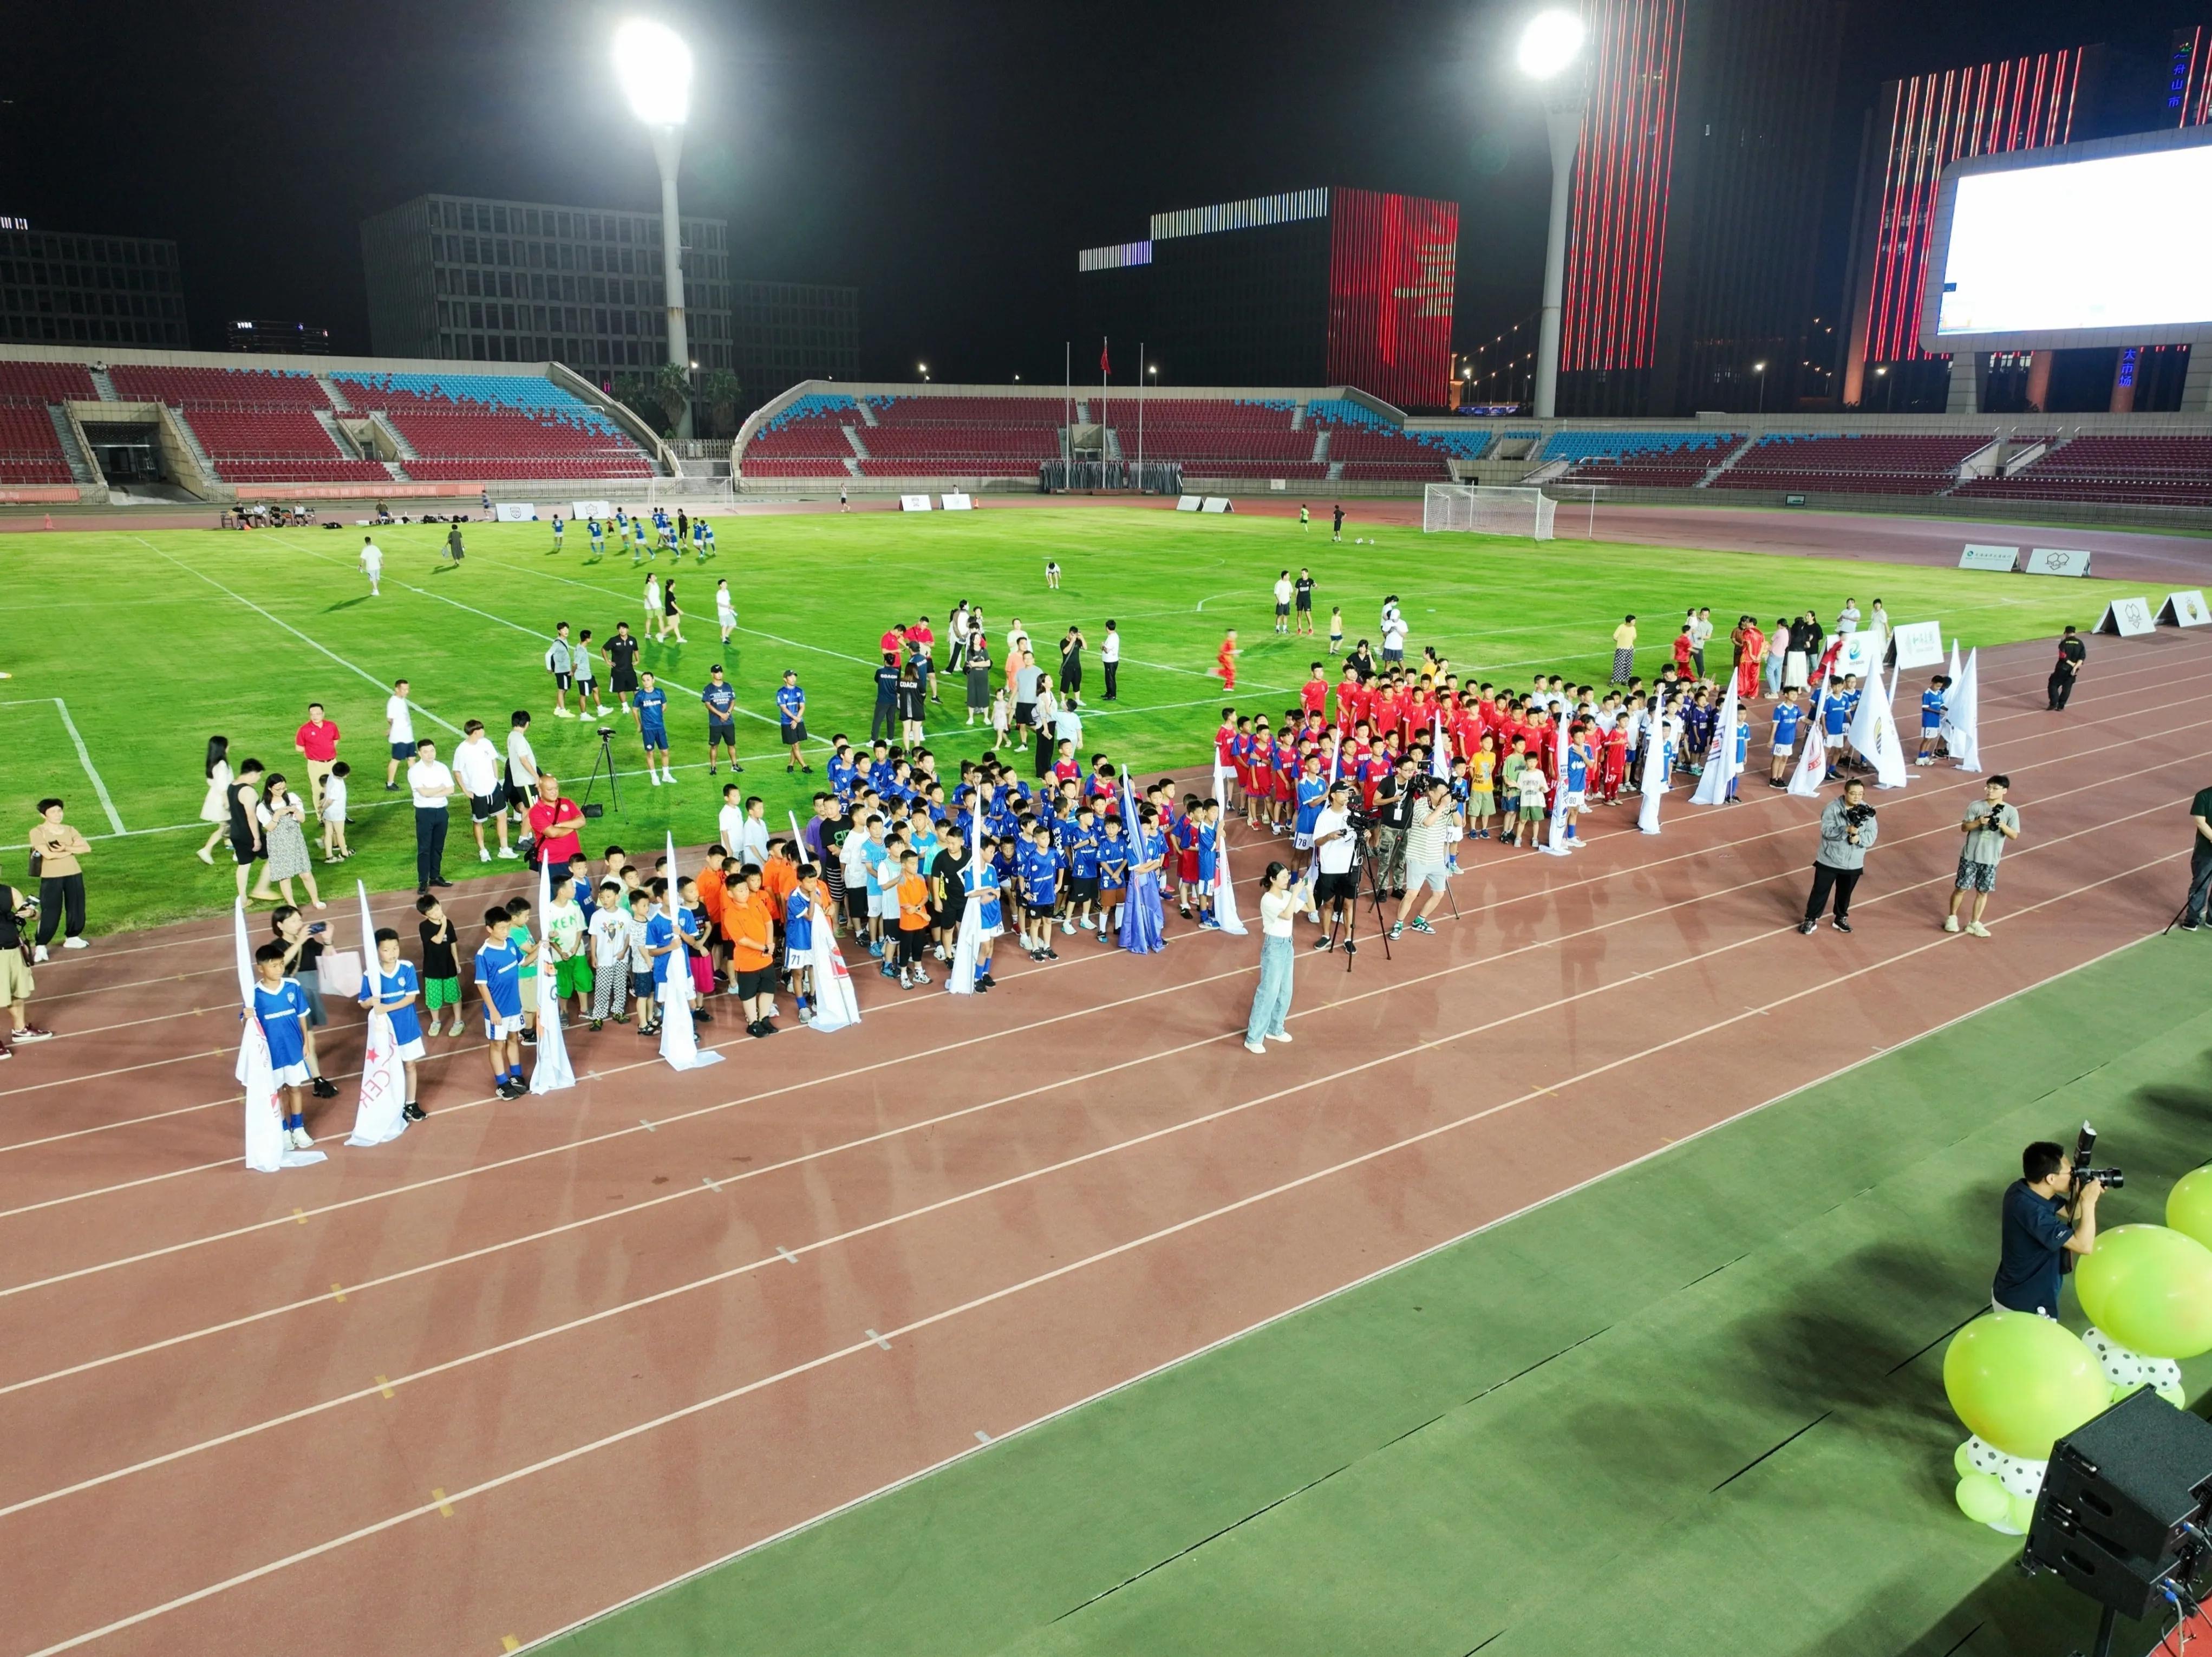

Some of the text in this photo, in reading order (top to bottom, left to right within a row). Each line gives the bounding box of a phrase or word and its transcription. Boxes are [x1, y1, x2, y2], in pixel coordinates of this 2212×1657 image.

[1299, 838, 1307, 847] 78
[791, 955, 800, 966] 71
[519, 1014, 525, 1025] 8
